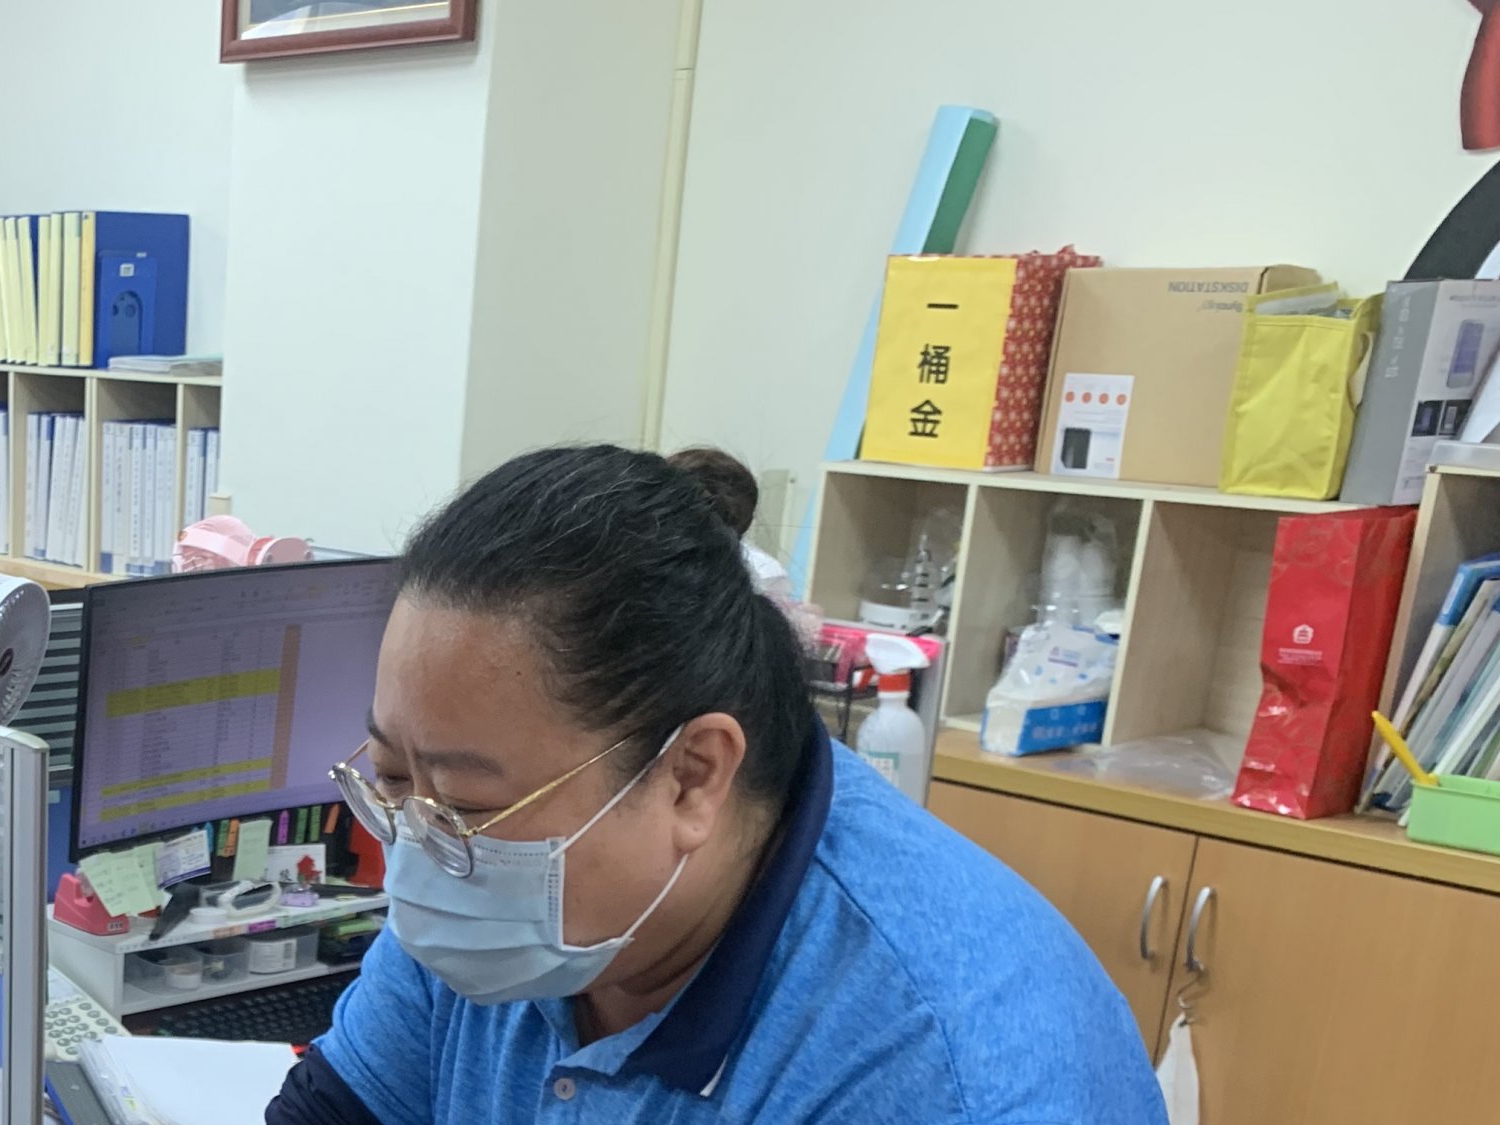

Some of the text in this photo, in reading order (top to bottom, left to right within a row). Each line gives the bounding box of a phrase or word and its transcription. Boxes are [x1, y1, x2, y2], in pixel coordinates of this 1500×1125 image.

[1167, 281, 1249, 293] DISKSTATION
[908, 303, 959, 438] 一桶金
